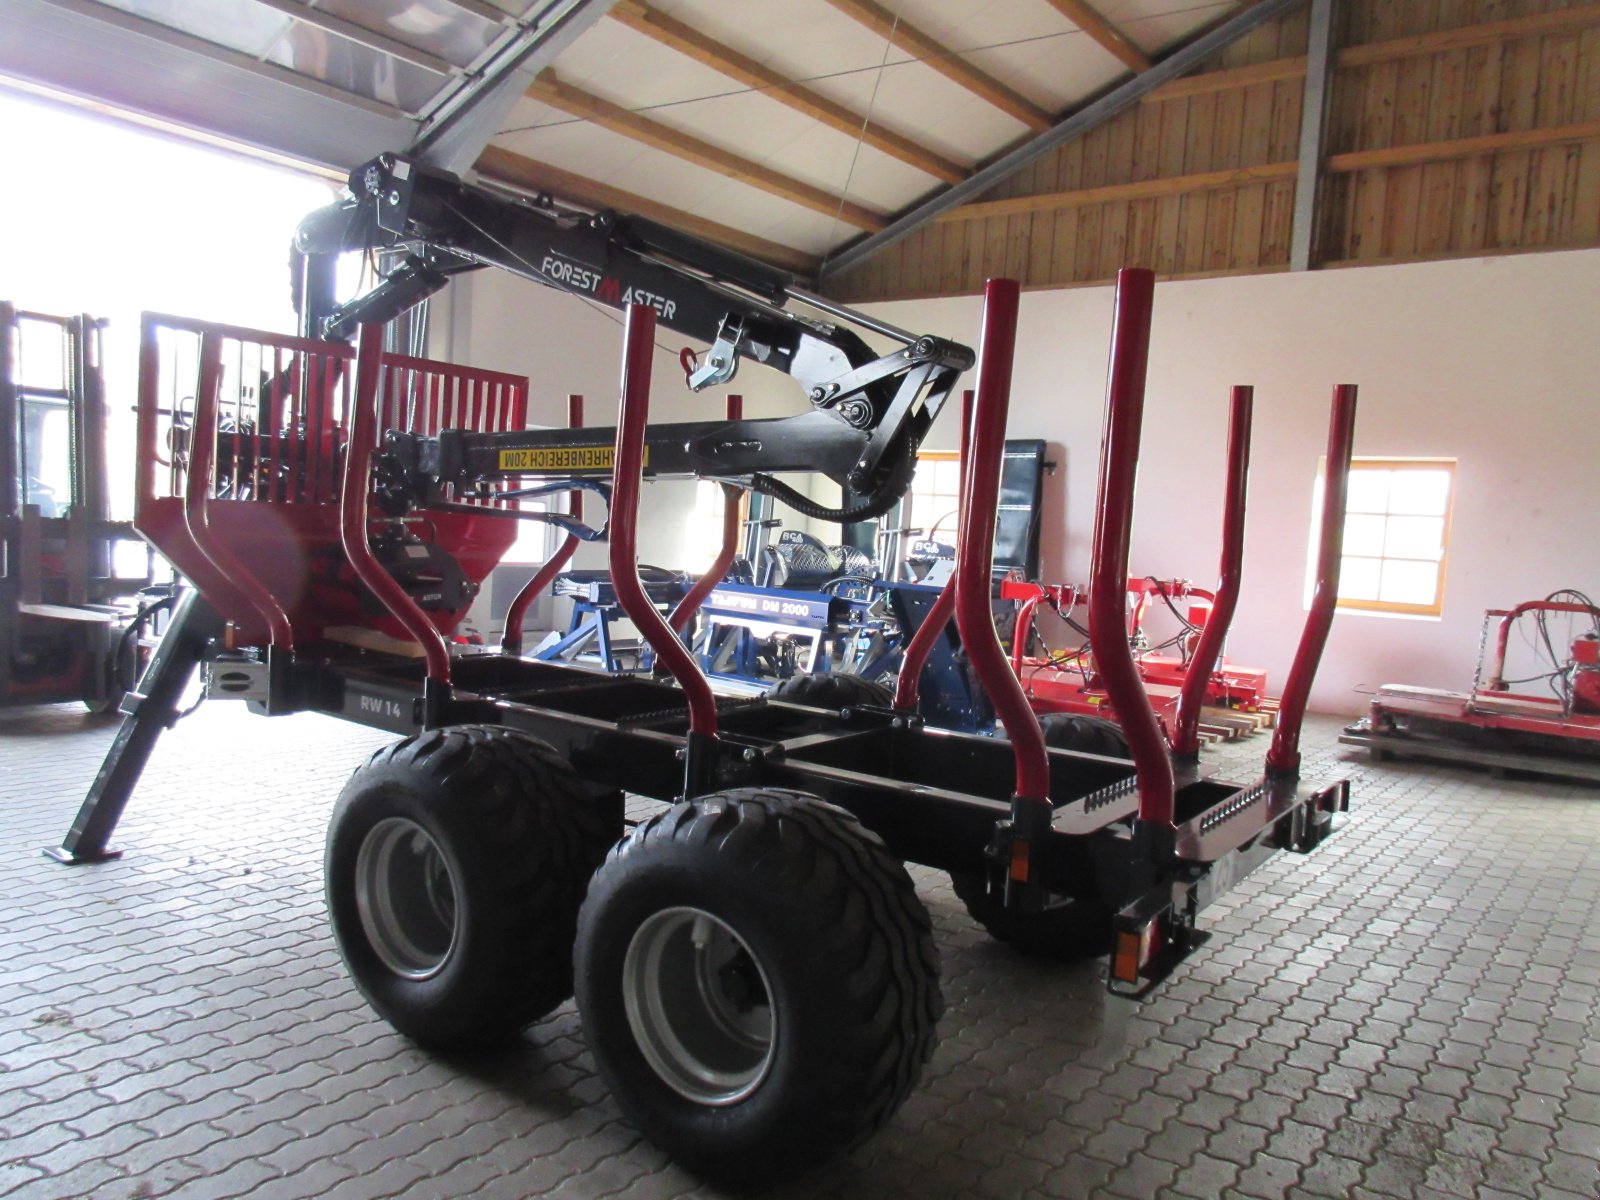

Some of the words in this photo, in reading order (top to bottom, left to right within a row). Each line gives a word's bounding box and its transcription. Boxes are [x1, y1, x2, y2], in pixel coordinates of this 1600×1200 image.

[505, 452, 527, 467] 20M
[762, 599, 779, 613] DM
[782, 602, 809, 617] 2000
[361, 695, 383, 713] RW
[385, 700, 401, 718] 14
